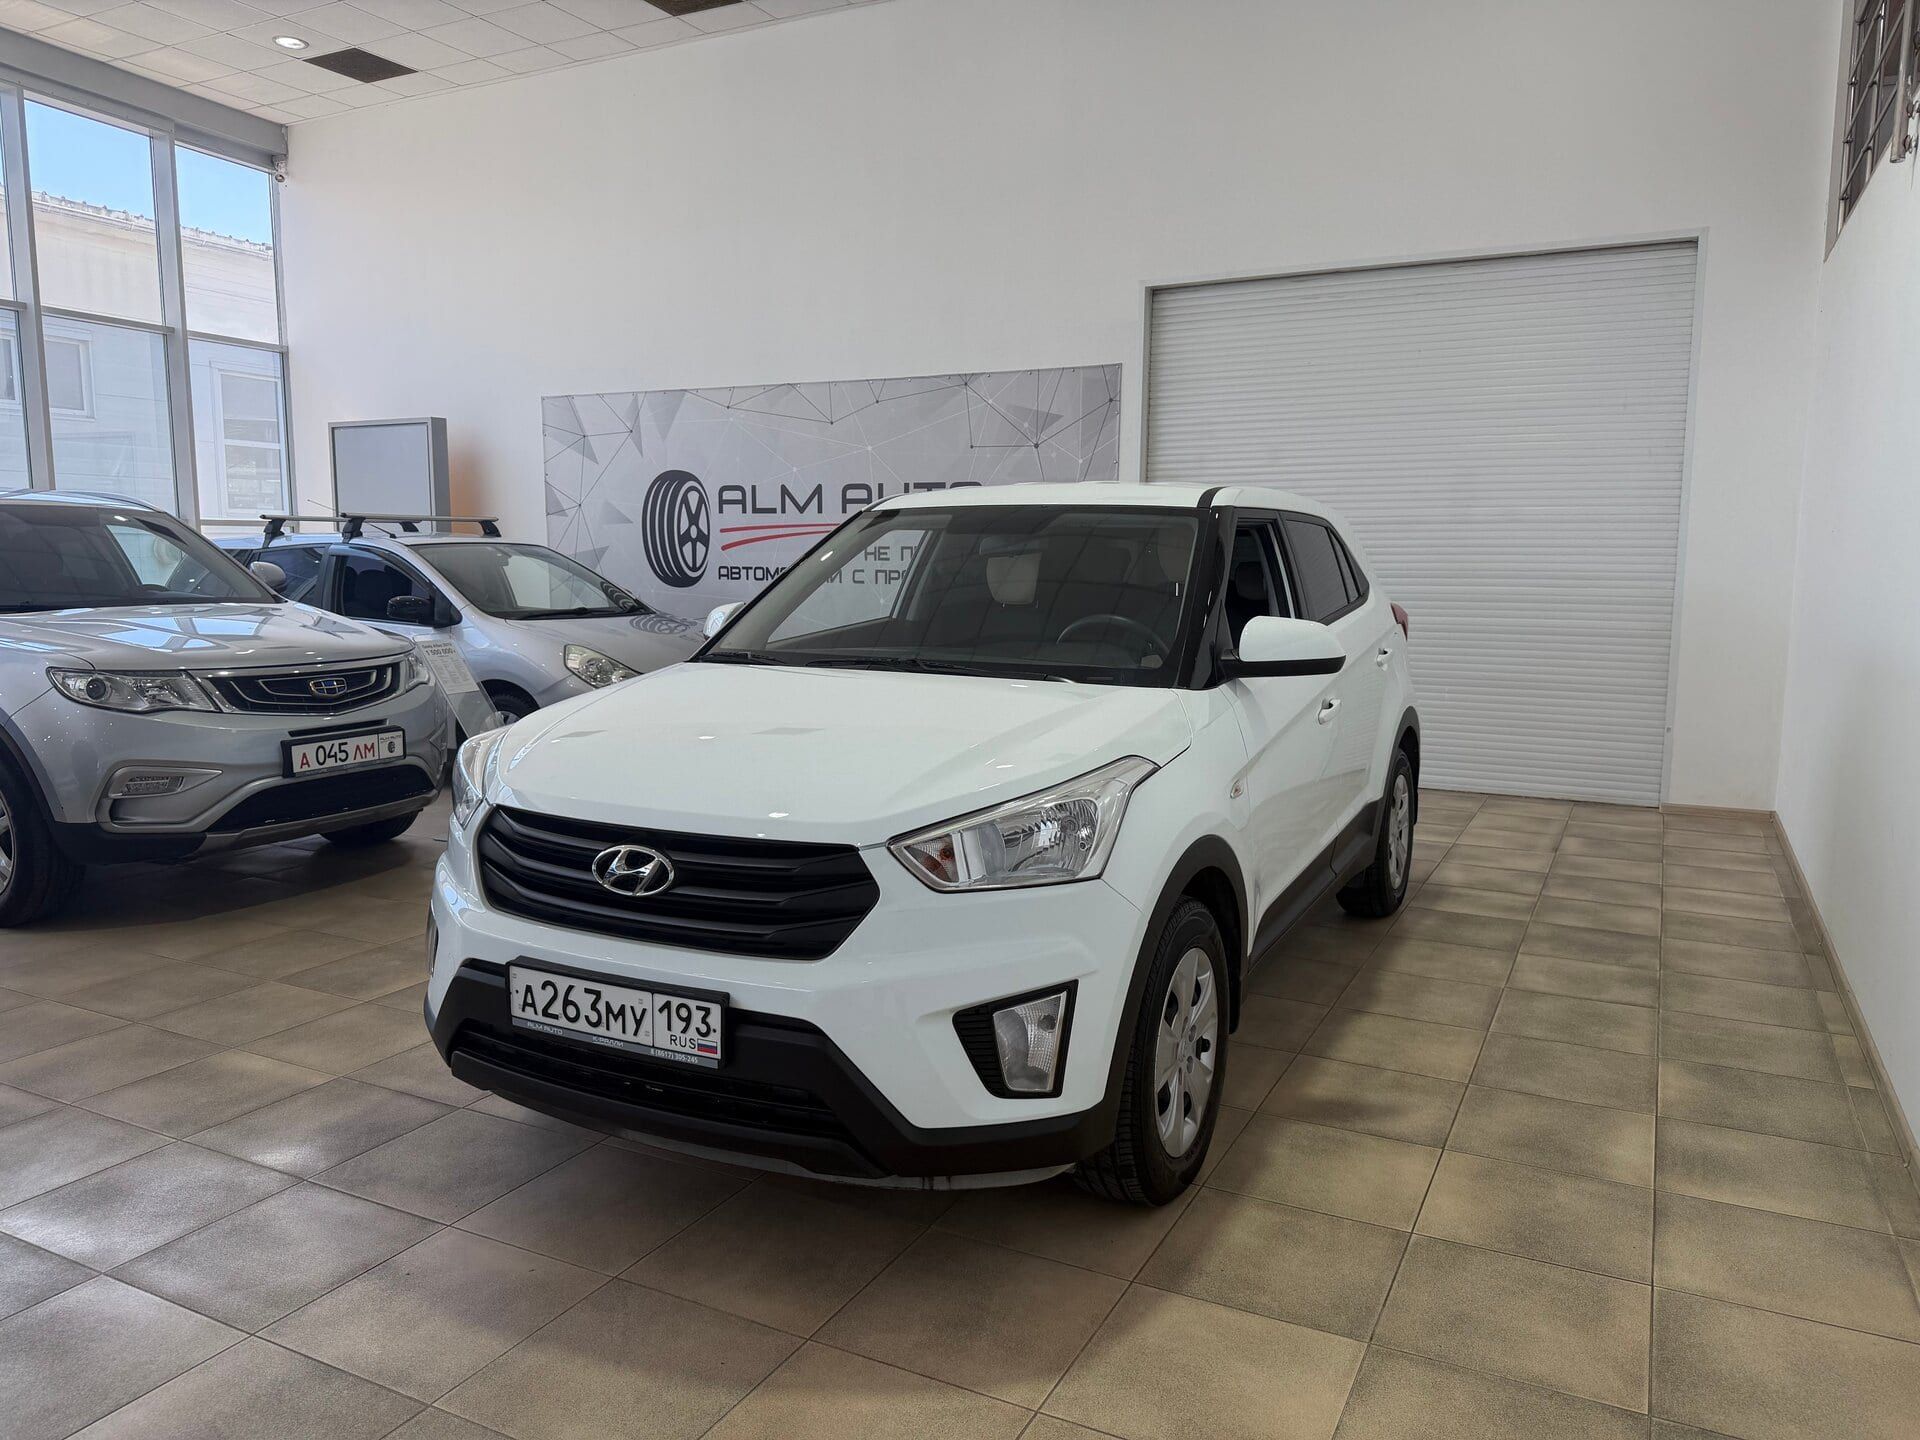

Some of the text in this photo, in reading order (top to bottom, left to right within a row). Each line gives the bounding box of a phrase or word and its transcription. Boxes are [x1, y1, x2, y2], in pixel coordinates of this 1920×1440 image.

[718, 483, 823, 514] ALM
[865, 546, 890, 561] НЕ
[852, 569, 865, 584] С
[299, 752, 311, 769] А
[315, 742, 349, 766] 045
[521, 980, 712, 1038] А263МУ 193
[544, 1025, 563, 1035] AUTO
[669, 1034, 696, 1050] RUS
